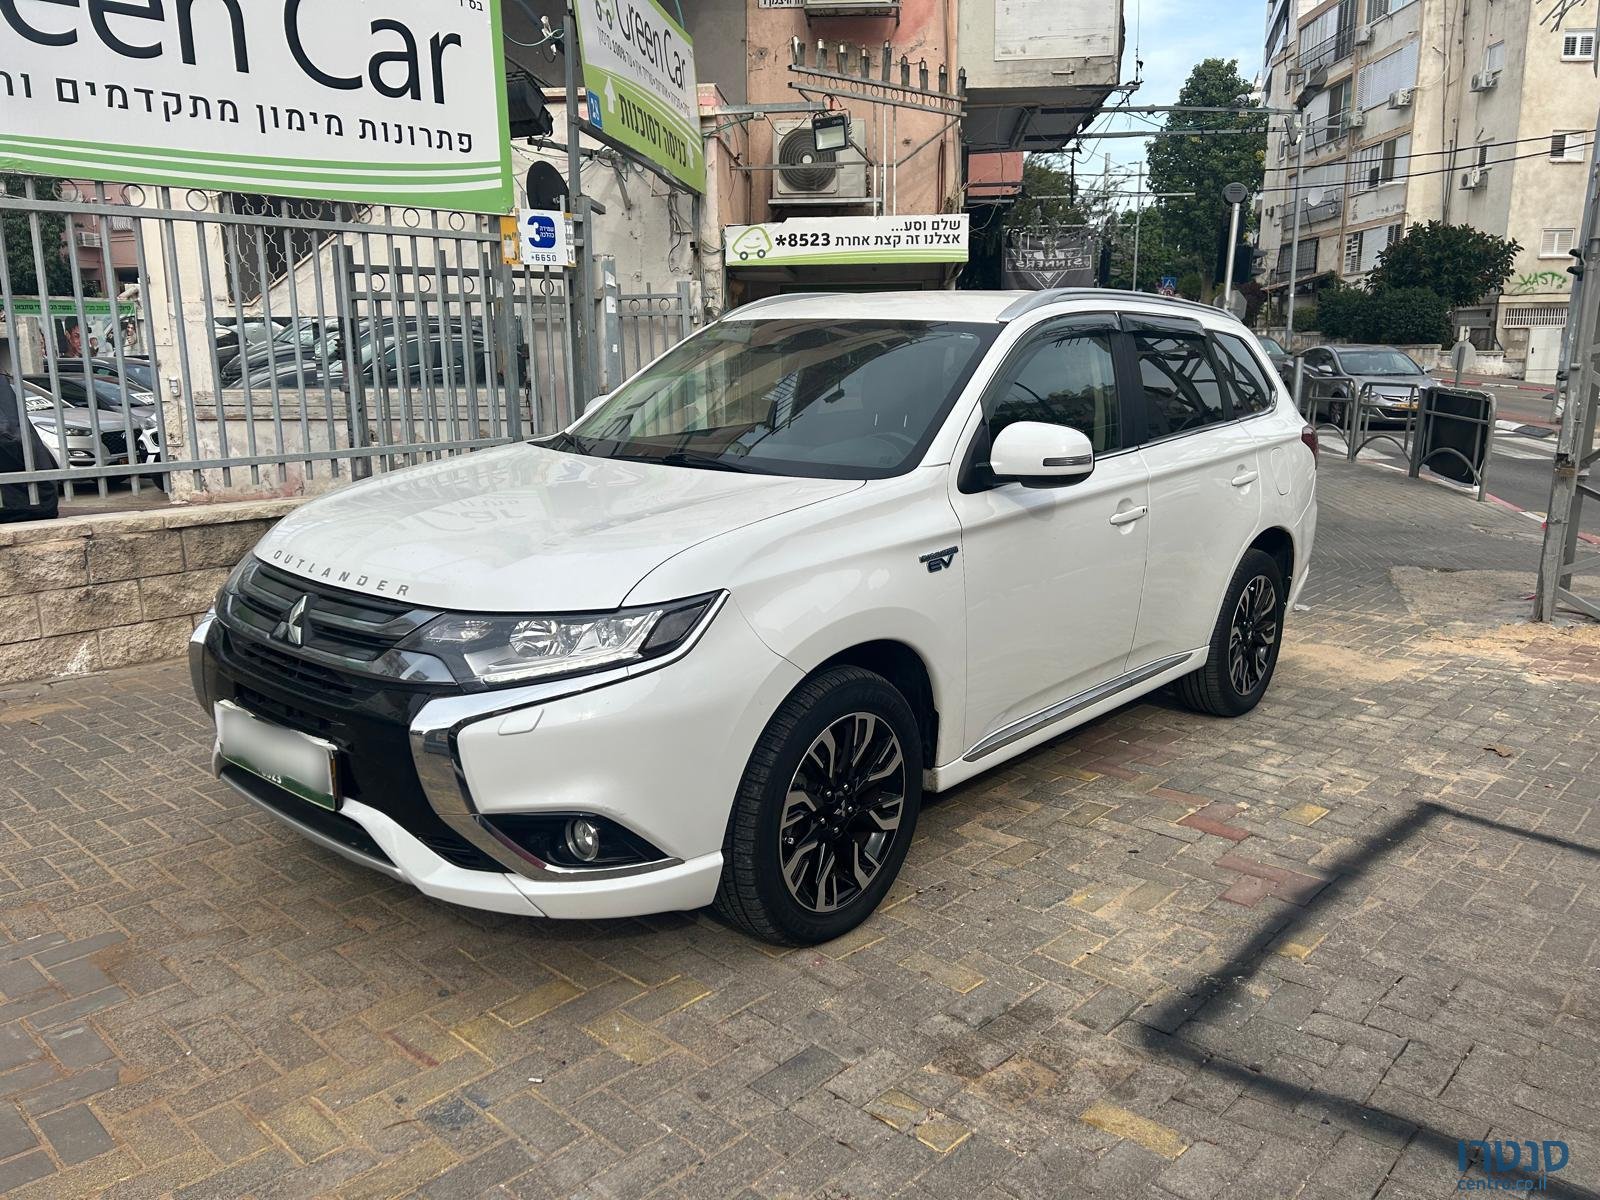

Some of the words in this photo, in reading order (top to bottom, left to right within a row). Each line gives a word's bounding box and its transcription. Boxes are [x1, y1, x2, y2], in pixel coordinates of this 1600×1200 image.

[283, 0, 462, 105] Car
[615, 0, 664, 73] Green
[663, 28, 687, 92] Car
[56, 77, 239, 123] מתקדמים
[255, 104, 344, 137] מימון
[358, 118, 473, 153] פתרונות
[618, 93, 662, 149] לסוכנות
[662, 125, 687, 167] כניסה
[834, 235, 870, 247] אחרת
[874, 234, 901, 248] קצת
[905, 234, 920, 245] זה
[924, 232, 961, 245] אצלנו
[931, 218, 961, 231] שלם
[273, 550, 410, 596] OUTLANDER
[928, 554, 955, 573] EV
